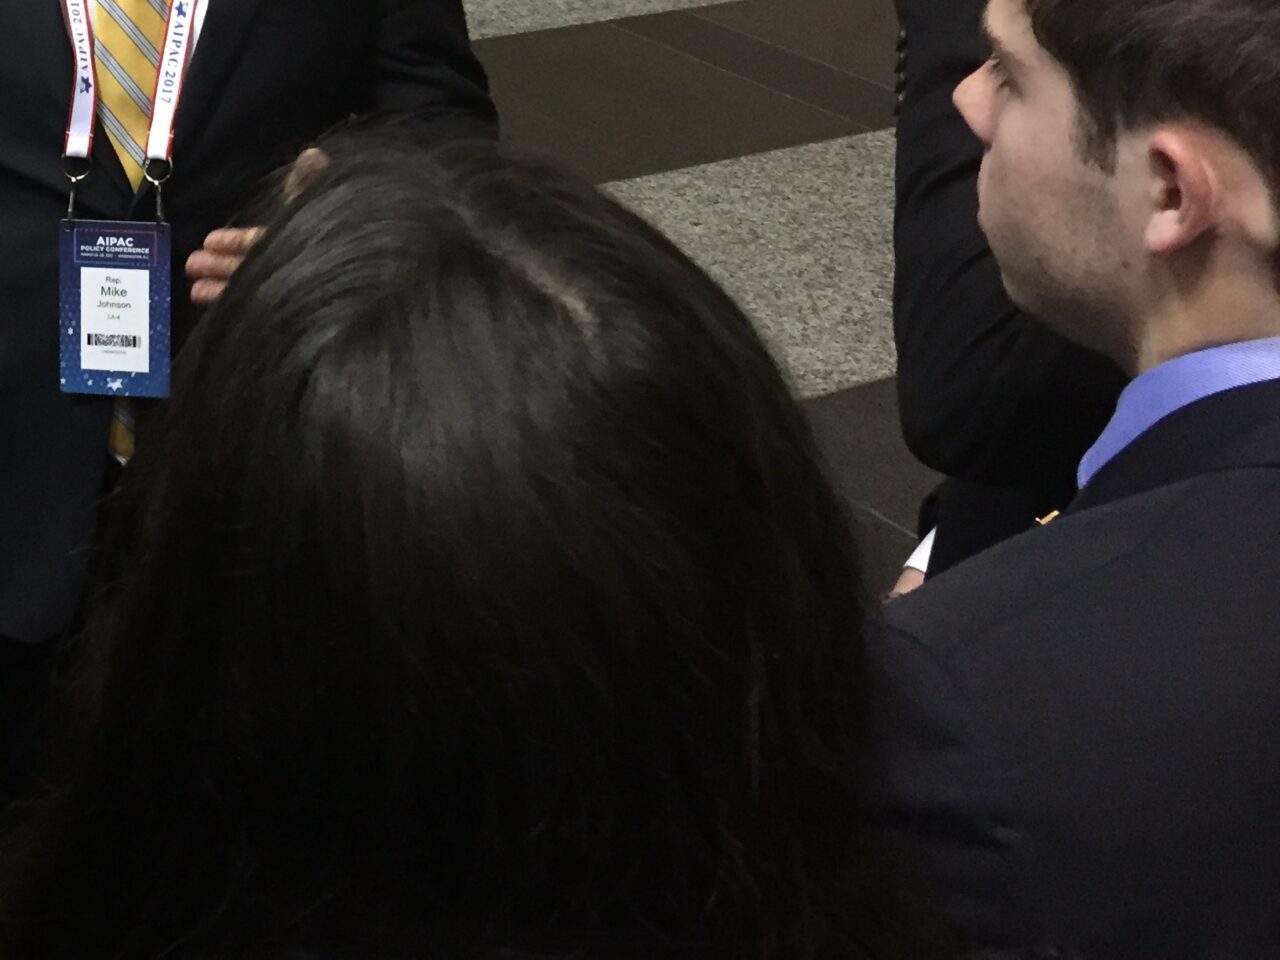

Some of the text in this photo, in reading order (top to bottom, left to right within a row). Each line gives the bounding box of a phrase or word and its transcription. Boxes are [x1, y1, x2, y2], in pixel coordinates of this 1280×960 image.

[160, 21, 184, 104] AIPAC 2017
[96, 235, 134, 247] AIPAC
[101, 286, 127, 297] Mike
[97, 300, 131, 309] Johnson
